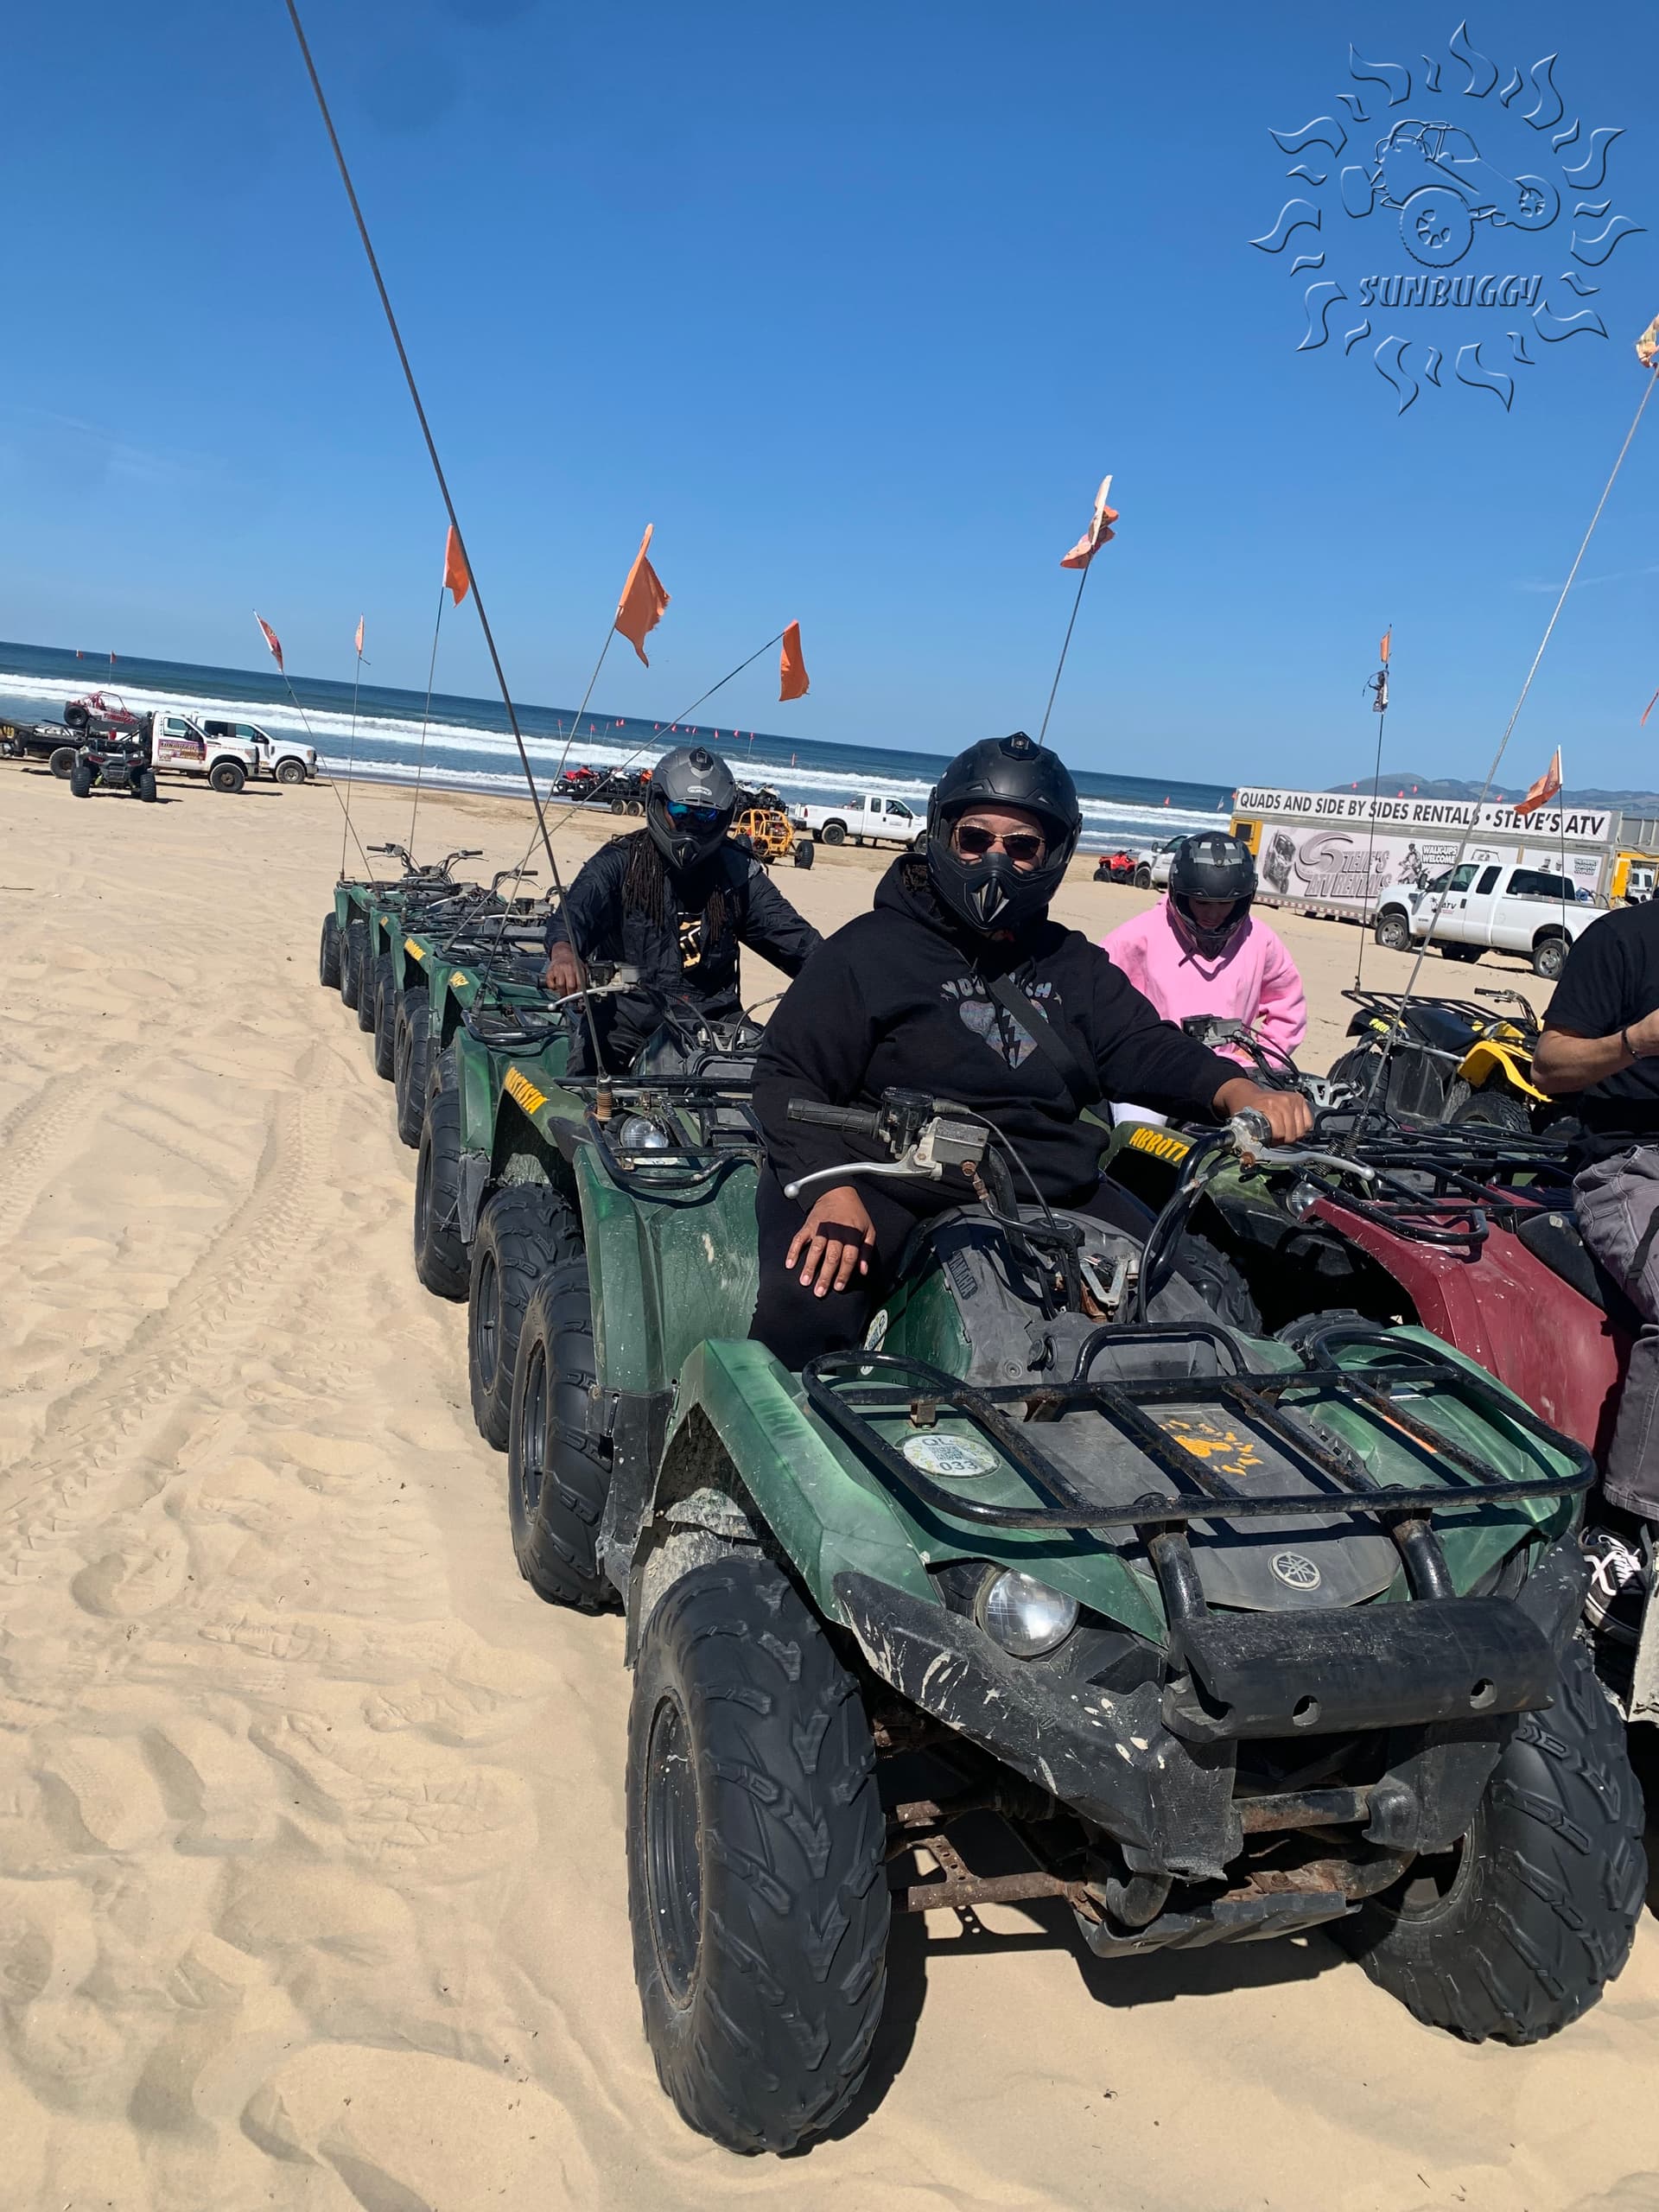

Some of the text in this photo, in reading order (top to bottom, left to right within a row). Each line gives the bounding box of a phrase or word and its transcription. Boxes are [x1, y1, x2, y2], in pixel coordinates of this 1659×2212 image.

[1240, 792, 1605, 836] QUADS AND SIDE BY SIDES RENTALS STEVE'S ATV
[948, 1249, 978, 1300] YAMAHA
[938, 1460, 979, 1471] 033
